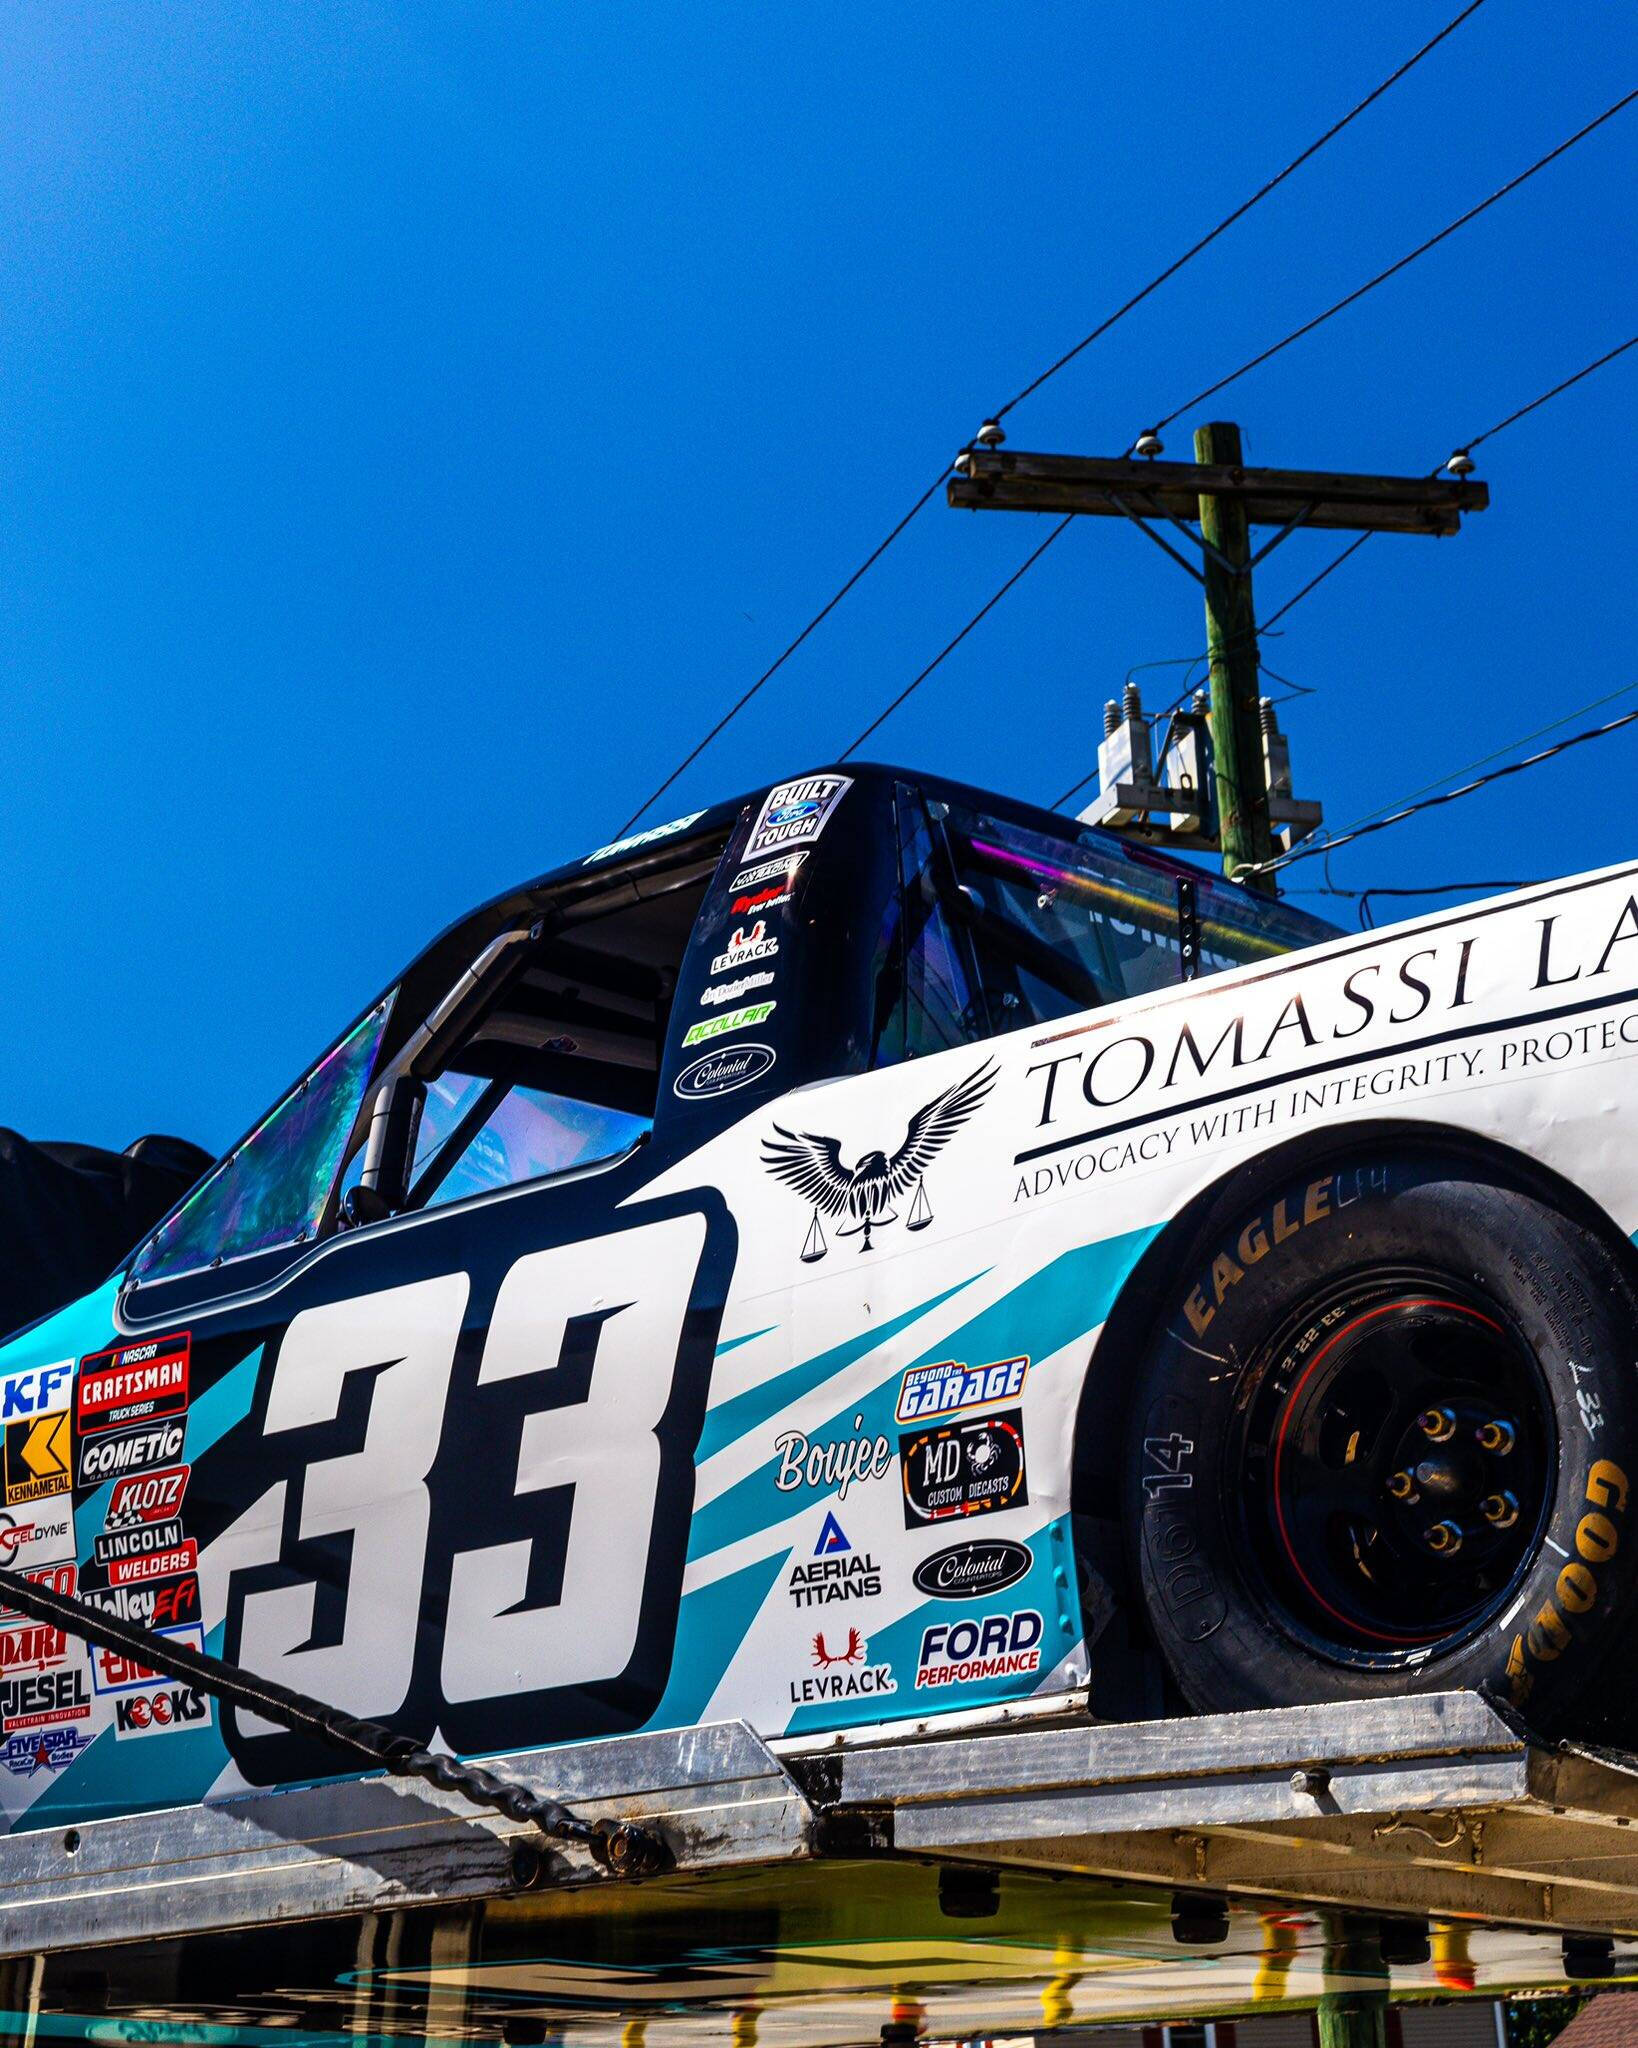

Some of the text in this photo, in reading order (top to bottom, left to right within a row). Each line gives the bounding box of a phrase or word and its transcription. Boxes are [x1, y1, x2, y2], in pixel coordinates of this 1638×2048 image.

[769, 781, 840, 811] BUILT
[777, 804, 809, 822] Ford
[755, 818, 818, 850] TOUGH
[1025, 937, 1481, 1130] TOMASSI
[693, 1053, 753, 1089] Colonial
[1012, 1127, 1181, 1204] ADVOCACY
[1190, 1097, 1279, 1146] WITH
[1290, 1049, 1485, 1119] INTEGRITY.
[1183, 1174, 1334, 1338] EAGLE
[121, 1343, 158, 1364] NASCAR
[82, 1360, 183, 1406] CRAFTSMAN
[898, 1359, 1026, 1419] GARAGE
[906, 1364, 953, 1387] BEYOND
[108, 1401, 155, 1423] TRUCK SERIES
[83, 1426, 183, 1476] COMETIC
[922, 1439, 961, 1487] MD
[7, 1475, 70, 1501] KENNAMETAL
[236, 1211, 708, 1739] 33
[927, 1476, 1010, 1506] CUSTOM DIECASTS
[117, 1475, 183, 1514] KLOTZ
[98, 1523, 178, 1560] LINCOLN
[118, 1551, 191, 1581] WELDERS
[789, 1552, 881, 1587] AERIAL
[937, 1550, 1007, 1587] Colonial
[789, 1574, 882, 1608] TITANS
[919, 1610, 1042, 1667] FORD
[916, 1651, 1040, 1688] PERFORMANCE
[2, 1670, 91, 1717] JESEL
[115, 1686, 207, 1732] KOOKS
[8, 1709, 87, 1729] VALVETRAIN INNOVATION
[8, 1729, 77, 1757] FIVE STAR
